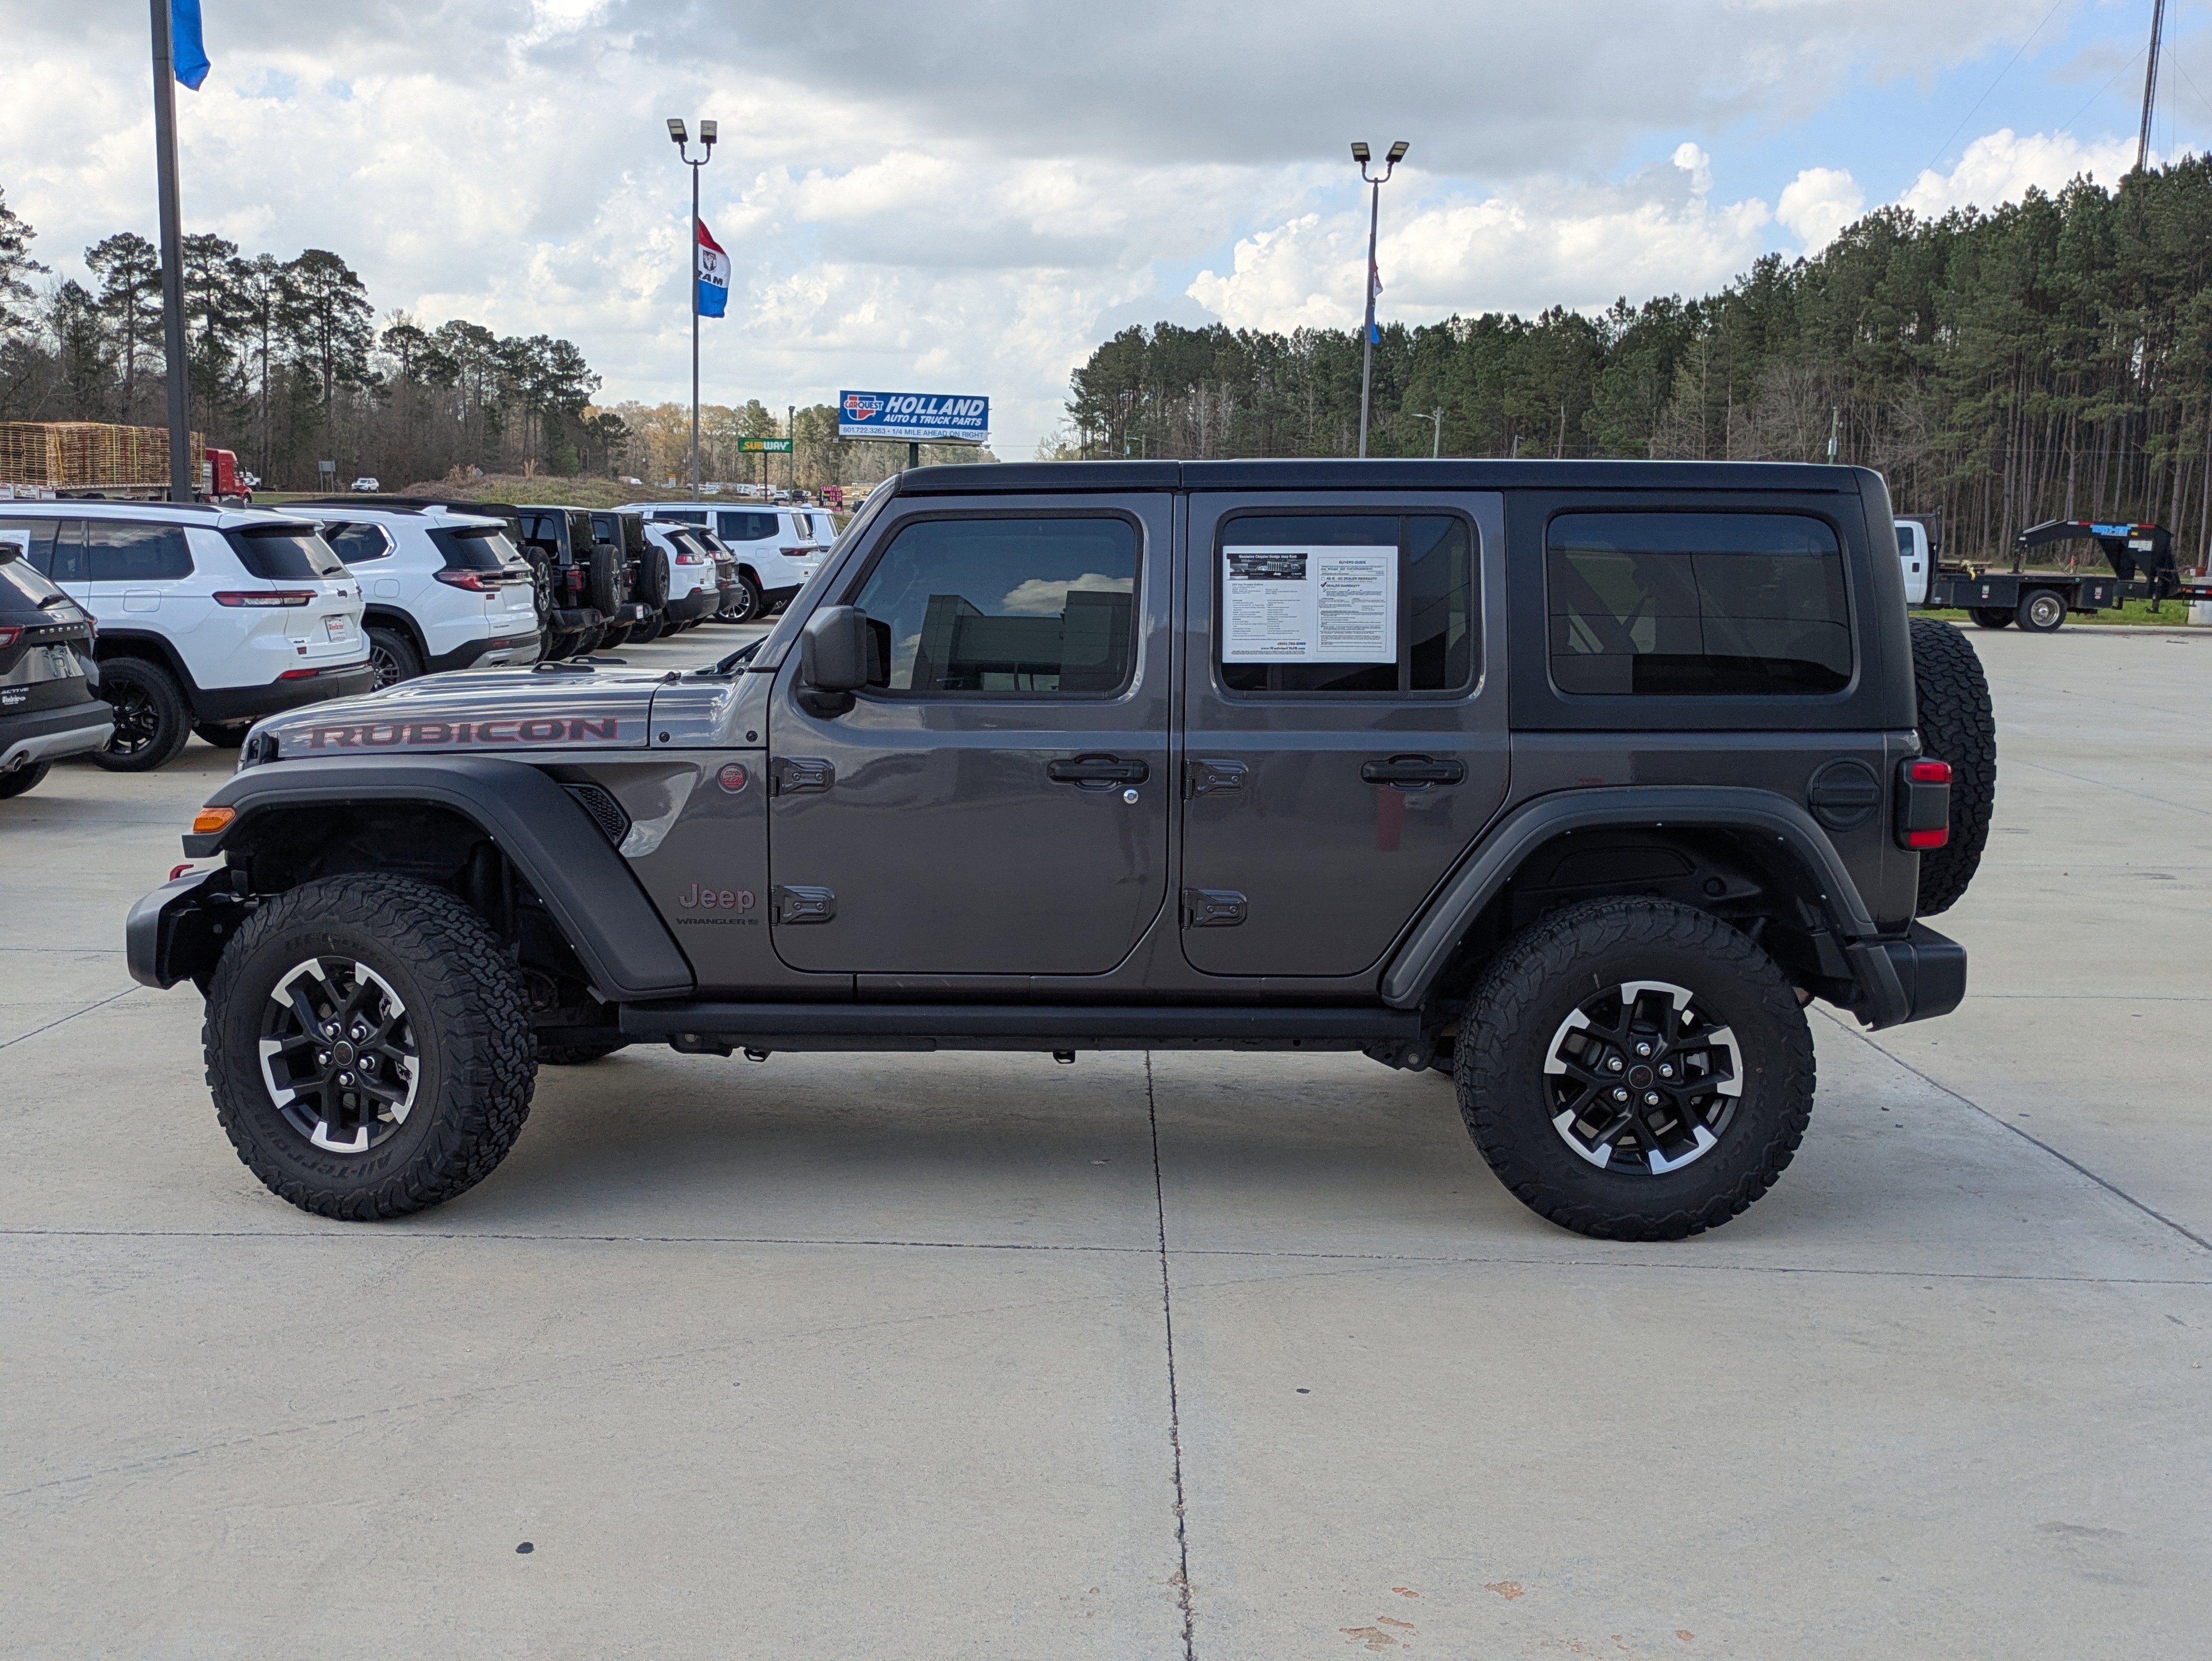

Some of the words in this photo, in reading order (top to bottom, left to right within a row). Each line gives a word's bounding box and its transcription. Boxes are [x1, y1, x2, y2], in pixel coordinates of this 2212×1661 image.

[845, 401, 882, 410] CARQUEST
[885, 396, 984, 416] HOLLAND
[883, 414, 910, 423] AUTO
[919, 415, 951, 425] TRUCK
[951, 417, 982, 426] PARTS
[743, 441, 789, 450] SUBWAY
[310, 718, 618, 749] RUBICON
[678, 882, 756, 914] Jeep
